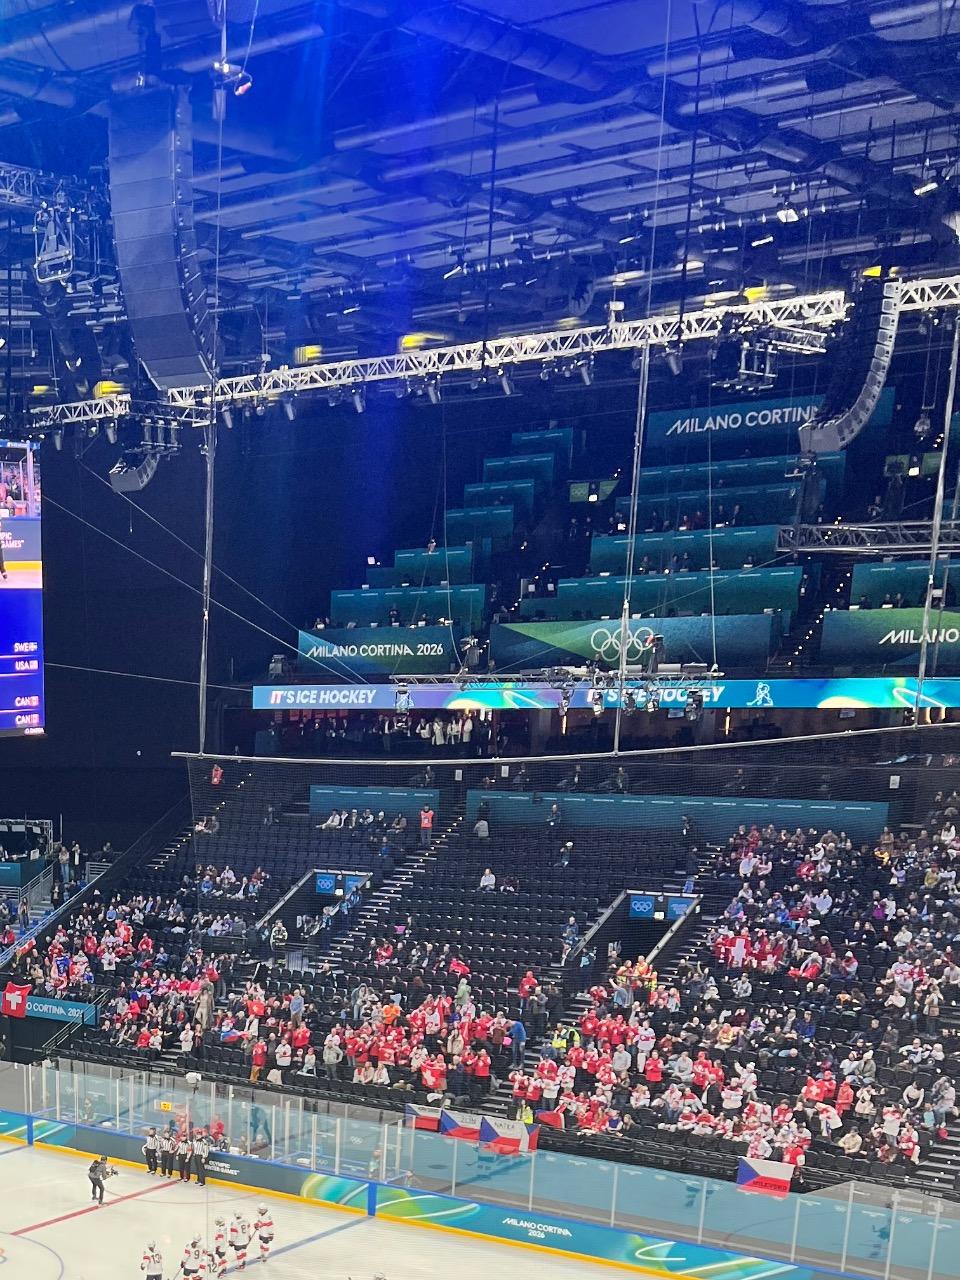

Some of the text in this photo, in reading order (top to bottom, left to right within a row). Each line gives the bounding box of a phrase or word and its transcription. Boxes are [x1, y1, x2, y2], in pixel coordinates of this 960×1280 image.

[666, 405, 819, 435] MILANO CORTIN
[879, 628, 959, 645] MILANO
[14, 642, 30, 652] SWE
[305, 643, 444, 658] MILANO CORTINA 2026
[15, 660, 30, 671] USA
[15, 696, 30, 706] CAN
[269, 689, 377, 704] IT'S ICE HOCKEY
[15, 714, 30, 725] CAN
[33, 1002, 67, 1016] CORTINA
[502, 1217, 572, 1237] MILANO CORTINA
[527, 1229, 546, 1239] 2026
